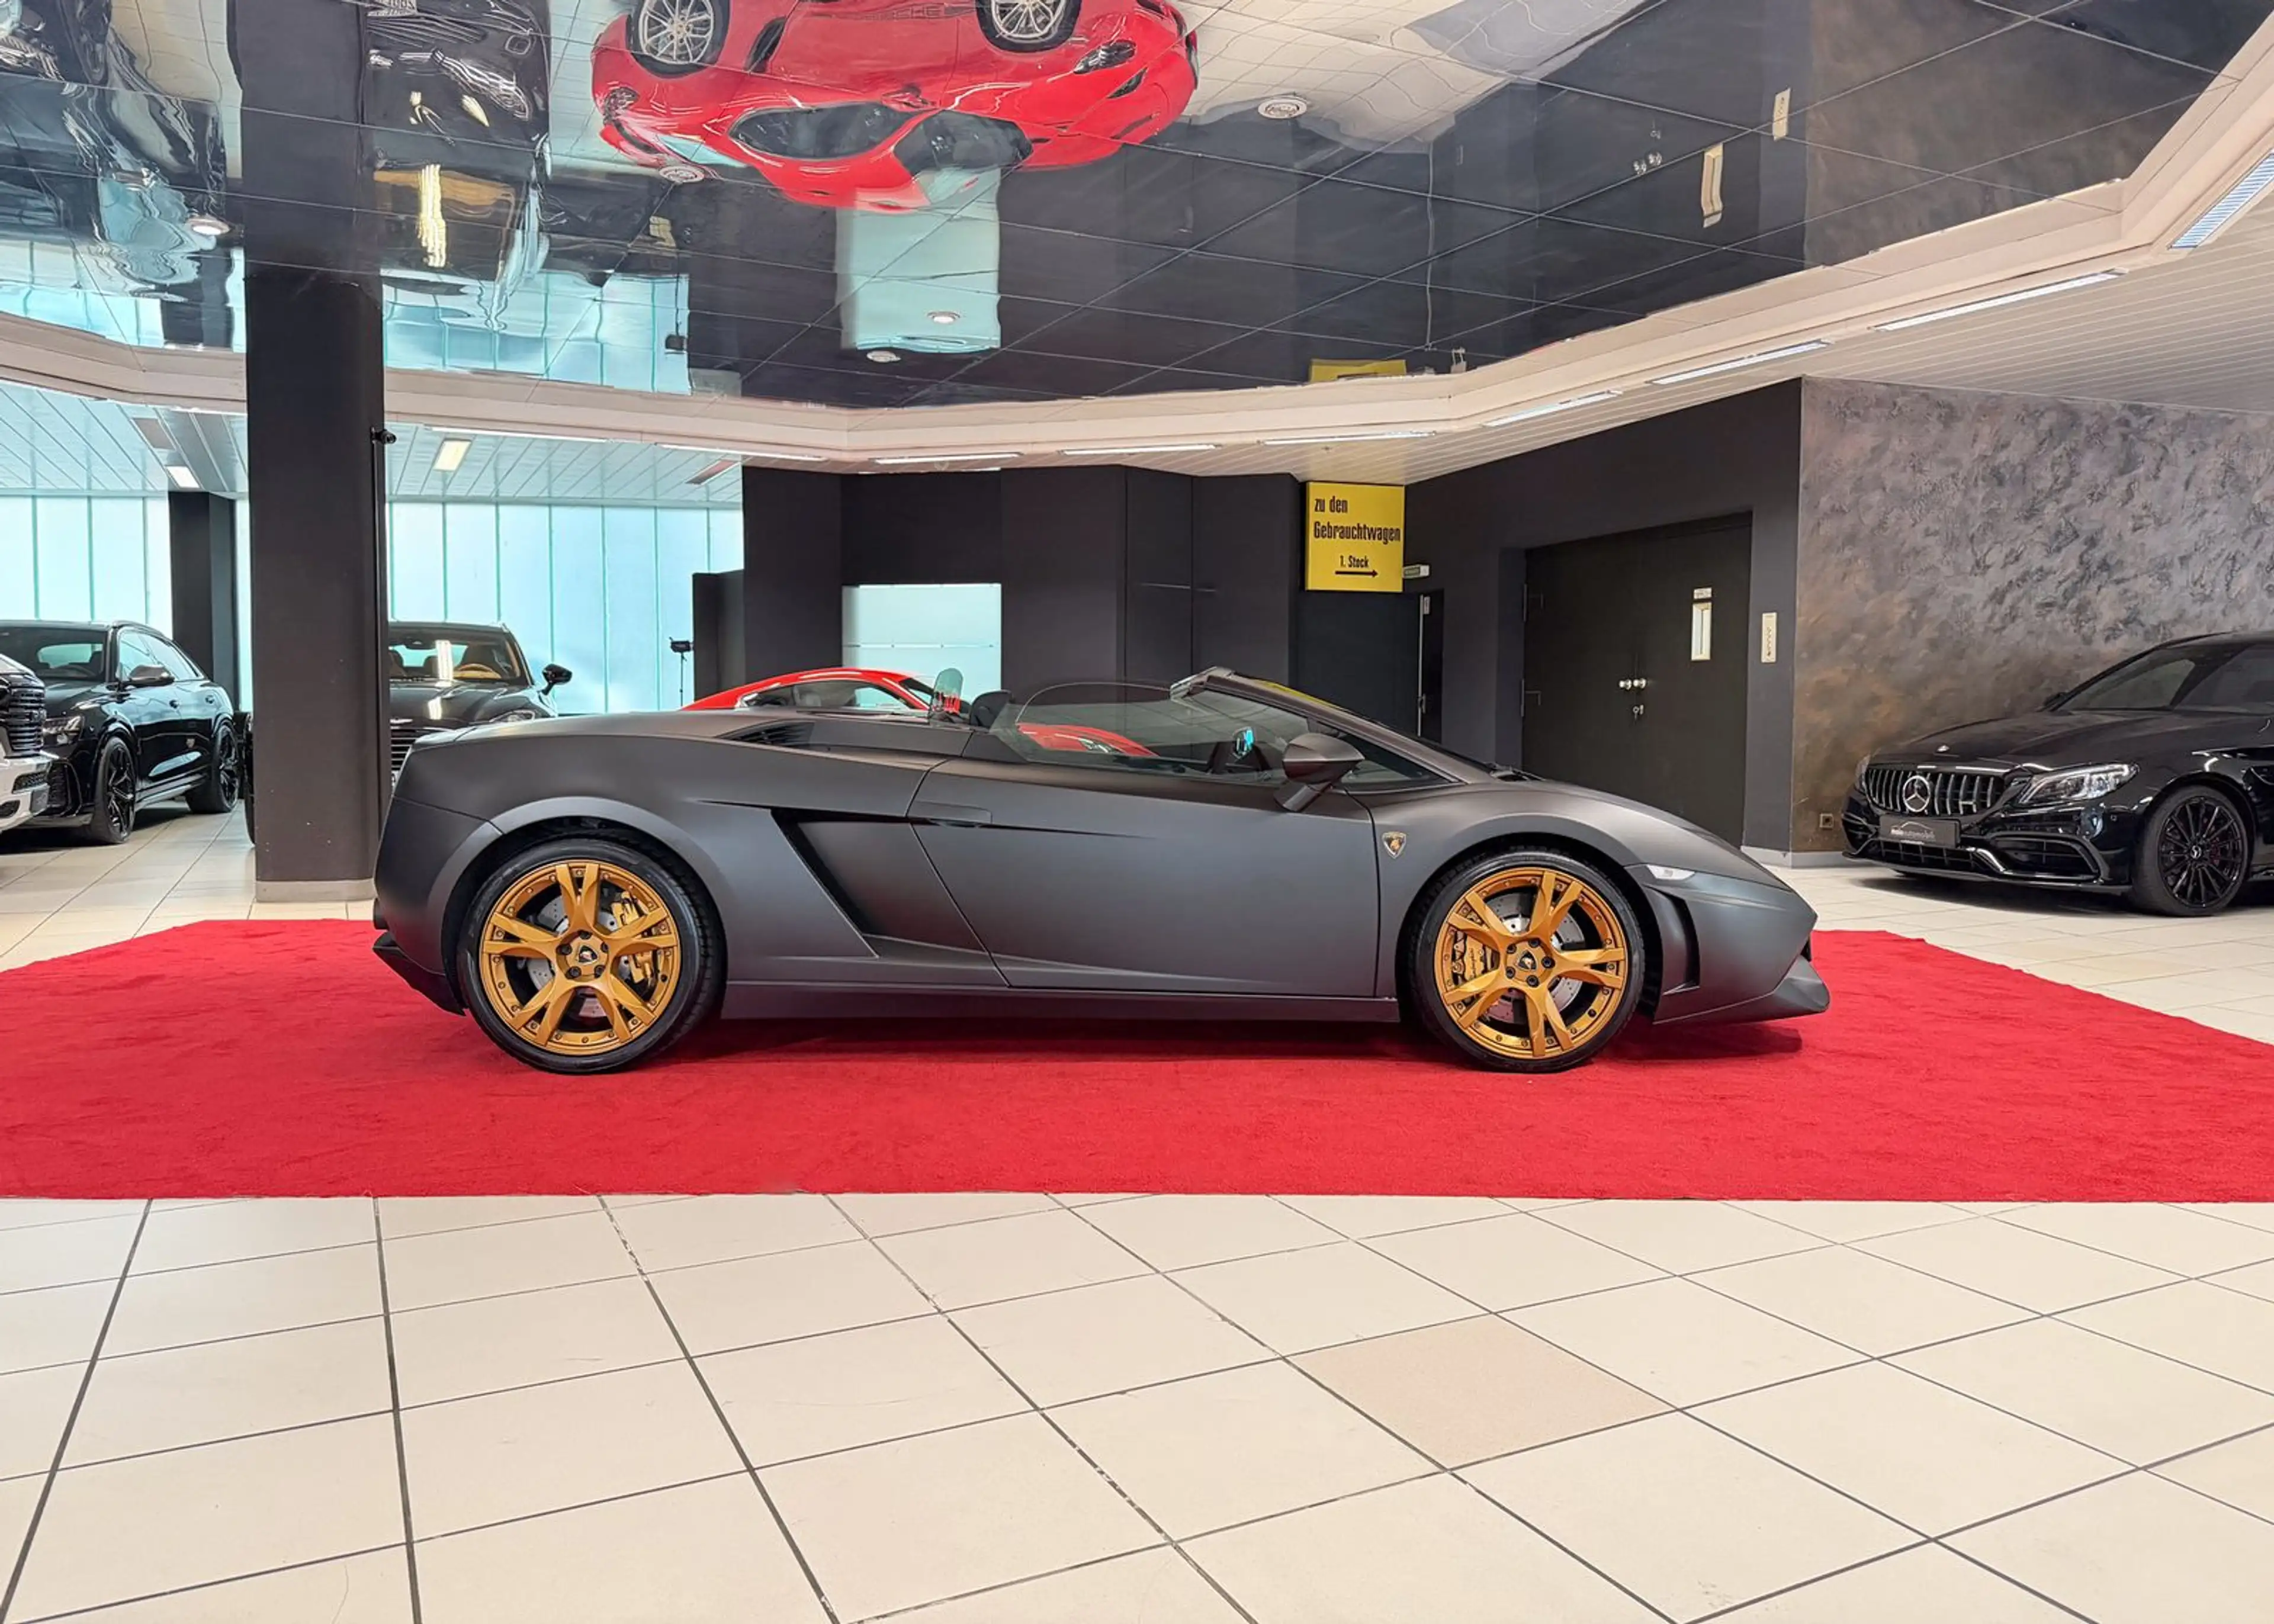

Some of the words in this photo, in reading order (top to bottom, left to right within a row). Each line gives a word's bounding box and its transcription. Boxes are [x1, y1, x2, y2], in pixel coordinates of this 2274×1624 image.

[1315, 499, 1325, 512] zu
[1329, 496, 1348, 513] den
[1314, 521, 1401, 545] Gebrauchtwagen
[1348, 555, 1369, 568] Stock
